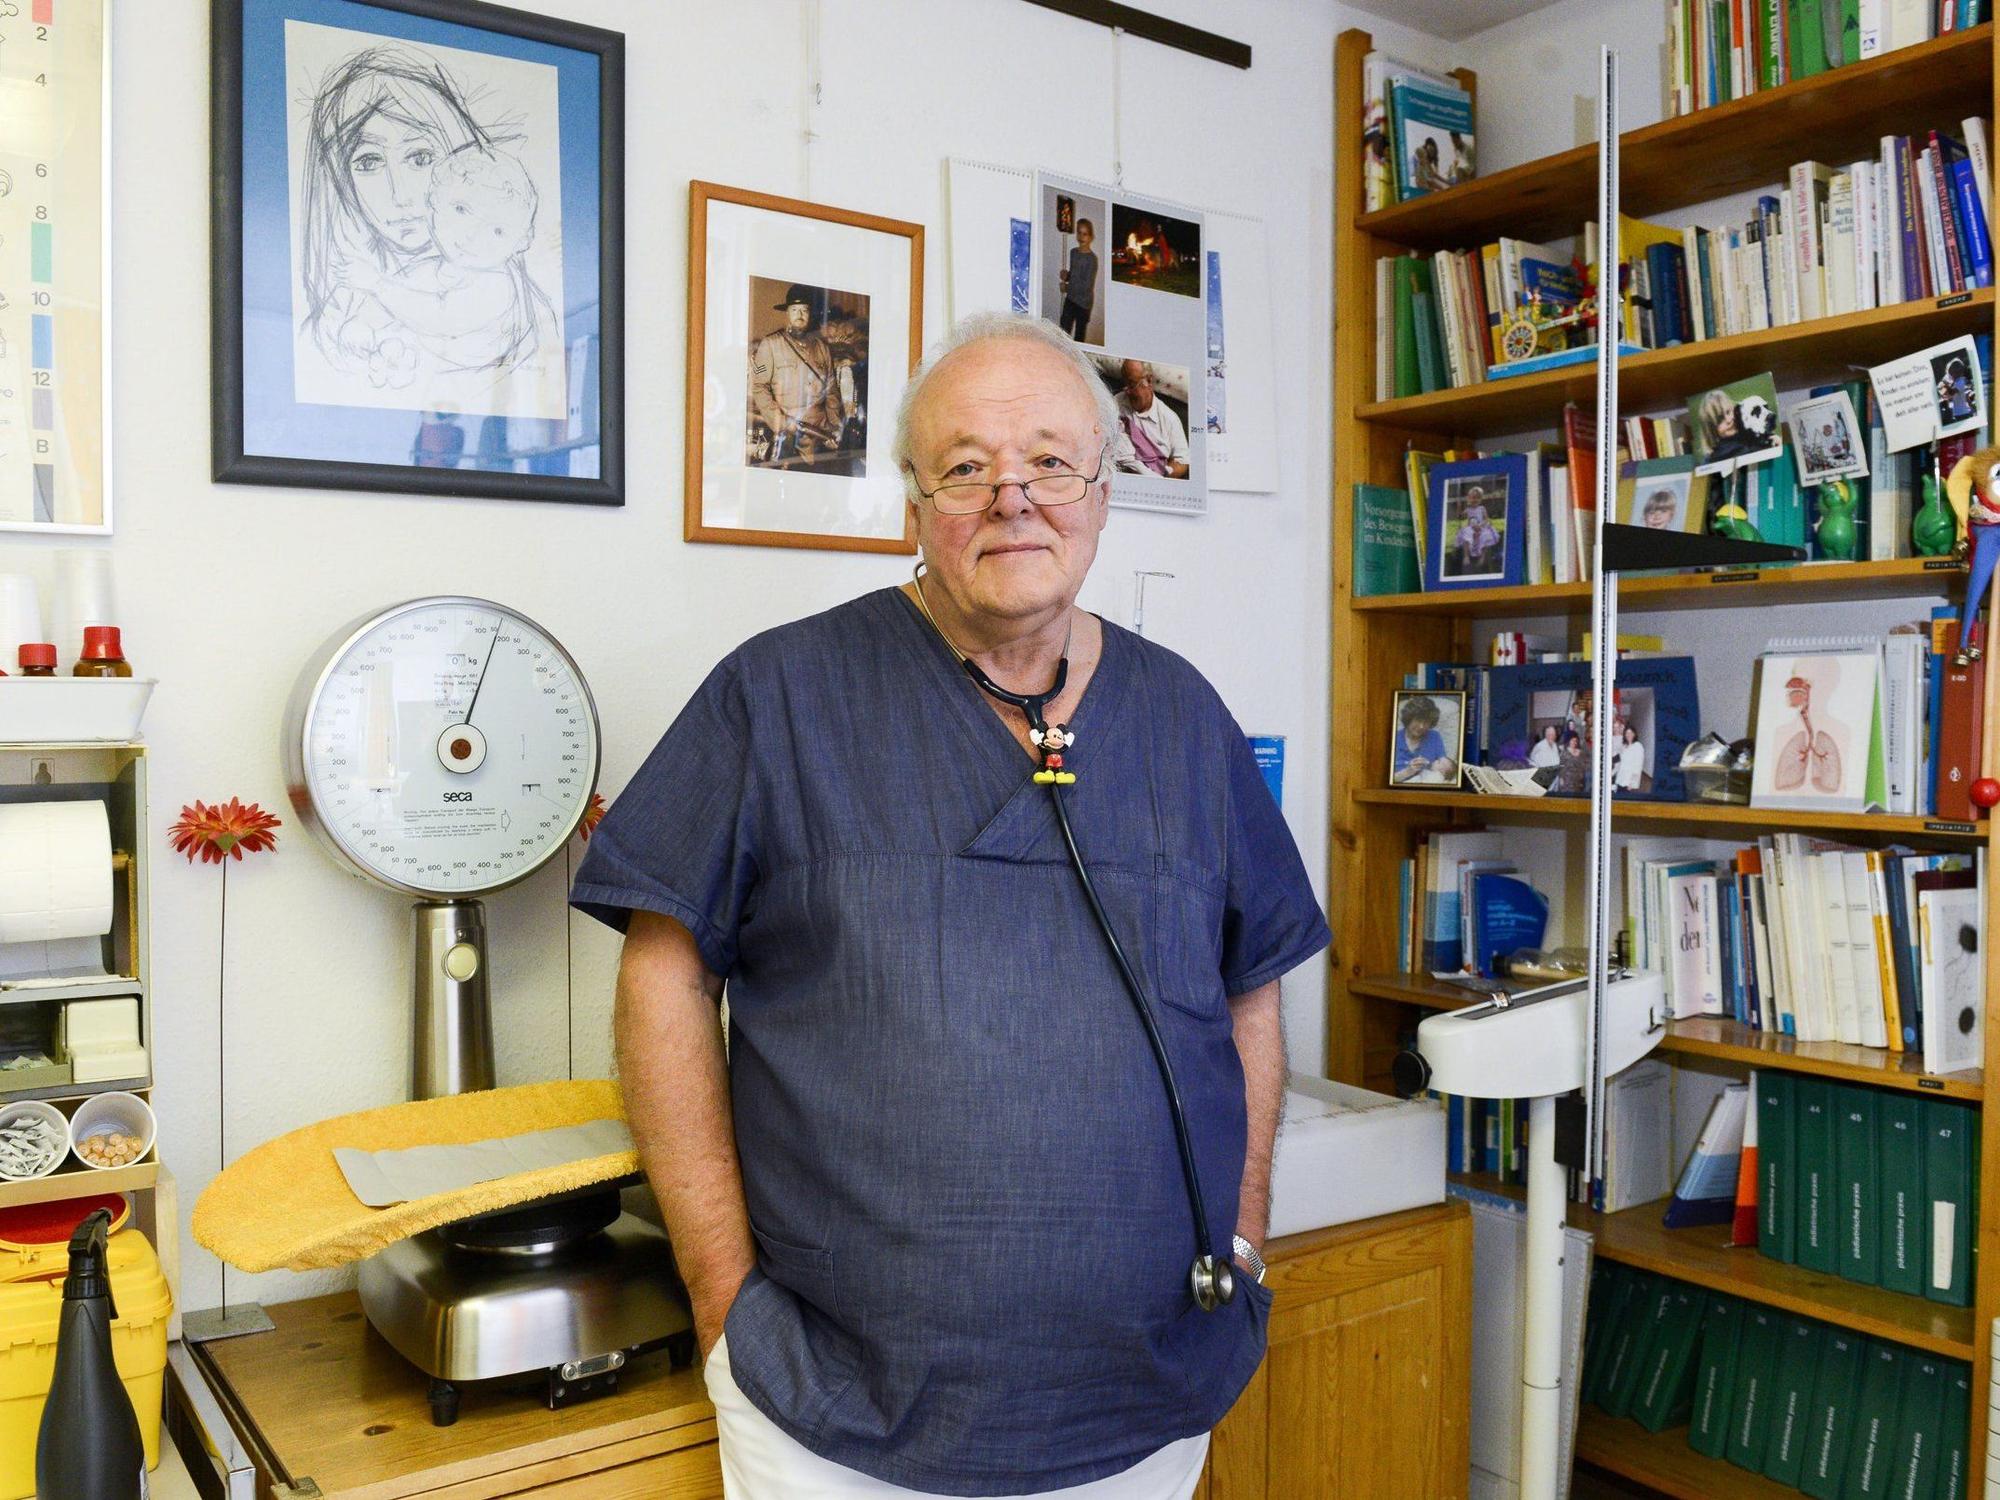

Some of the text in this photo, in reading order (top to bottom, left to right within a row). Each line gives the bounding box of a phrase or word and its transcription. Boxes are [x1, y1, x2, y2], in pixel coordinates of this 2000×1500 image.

[36, 27, 47, 42] 2
[35, 74, 47, 87] 4
[35, 164, 47, 178] 6
[35, 206, 47, 220] 8
[32, 292, 50, 306] 10
[33, 372, 50, 386] 12
[468, 656, 478, 665] kg
[443, 791, 472, 803] seca
[1939, 1129, 1952, 1139] 47
[1811, 1198, 1819, 1248] pädiatrische
[1853, 1183, 1862, 1259] pädiatrische praxis
[1898, 1192, 1906, 1270] pädiatrische praxis
